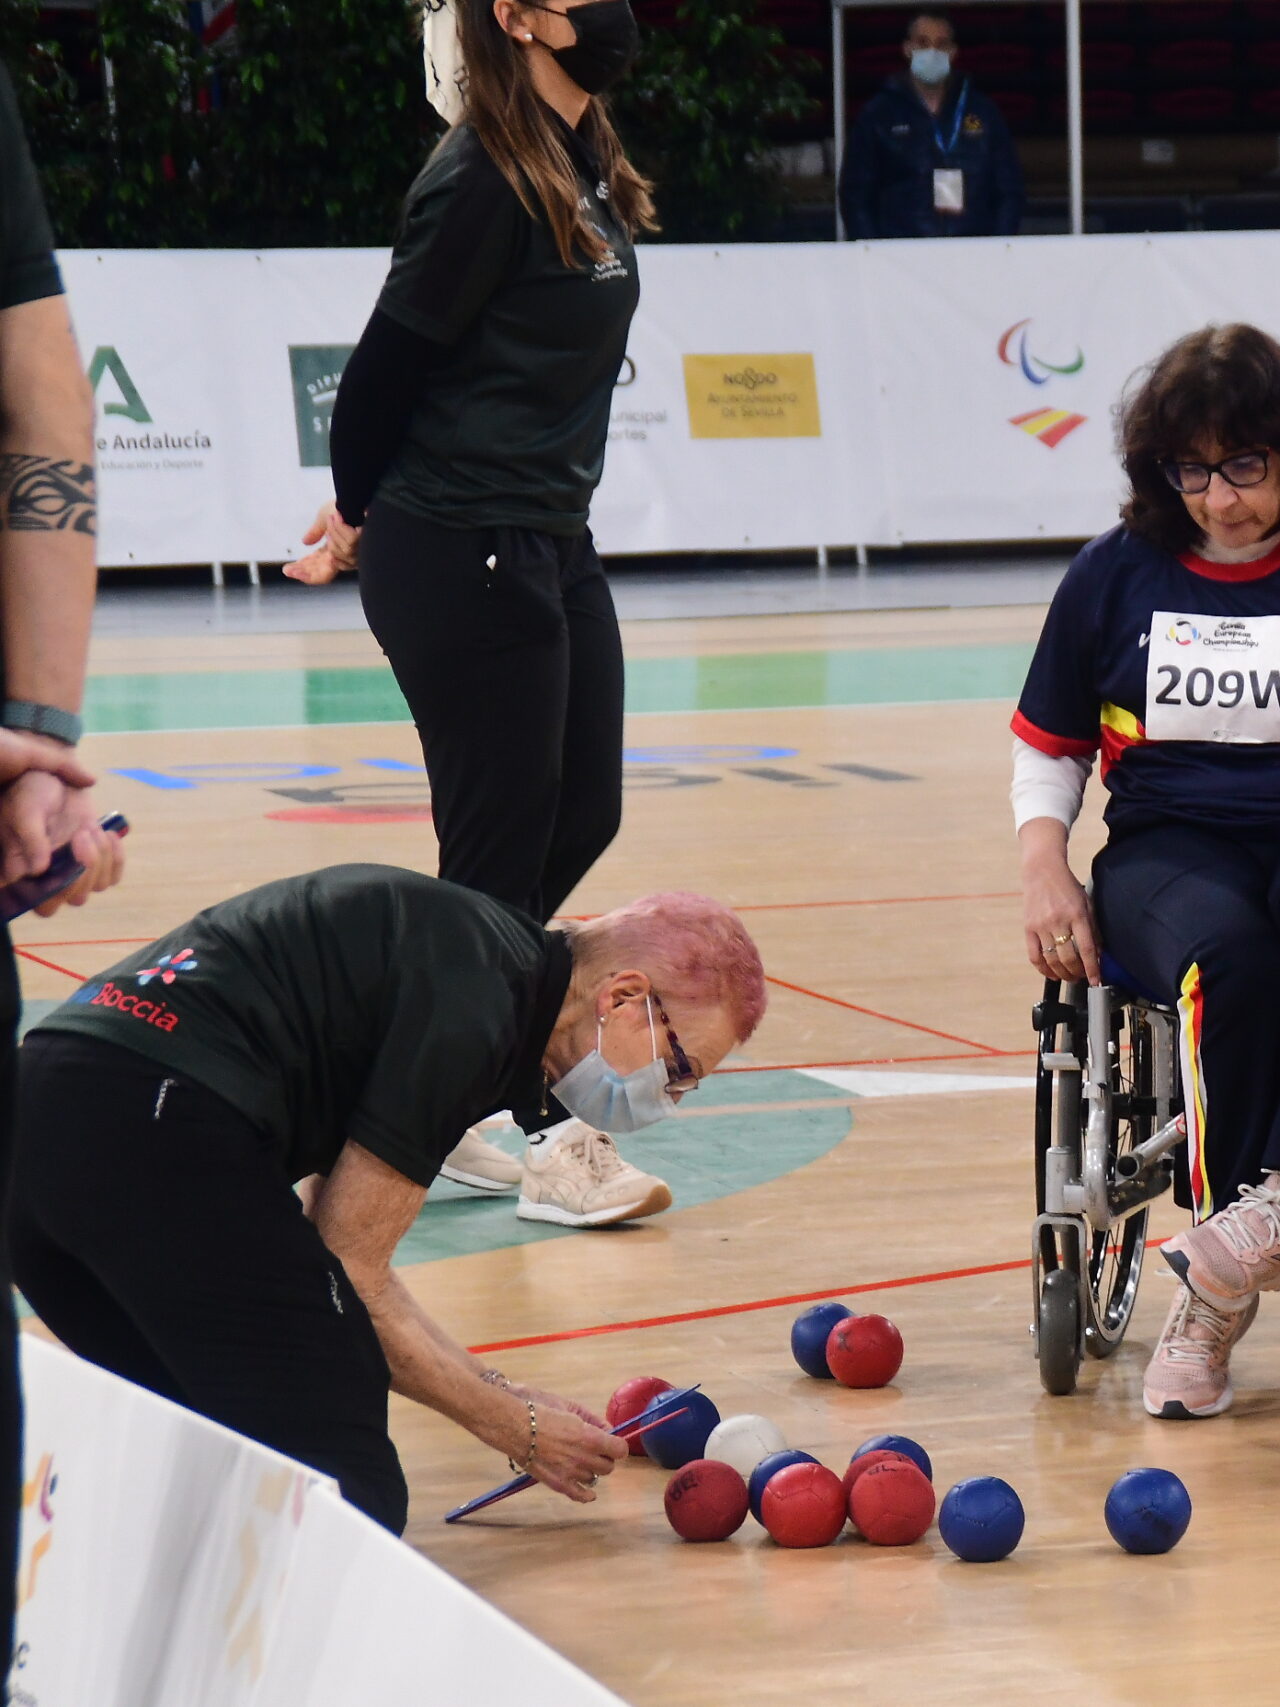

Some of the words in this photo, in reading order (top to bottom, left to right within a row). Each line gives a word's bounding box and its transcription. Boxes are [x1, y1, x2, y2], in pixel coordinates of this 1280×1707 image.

[609, 408, 668, 426] unicipal
[112, 430, 212, 450] Andalucía
[607, 427, 648, 441] ortes
